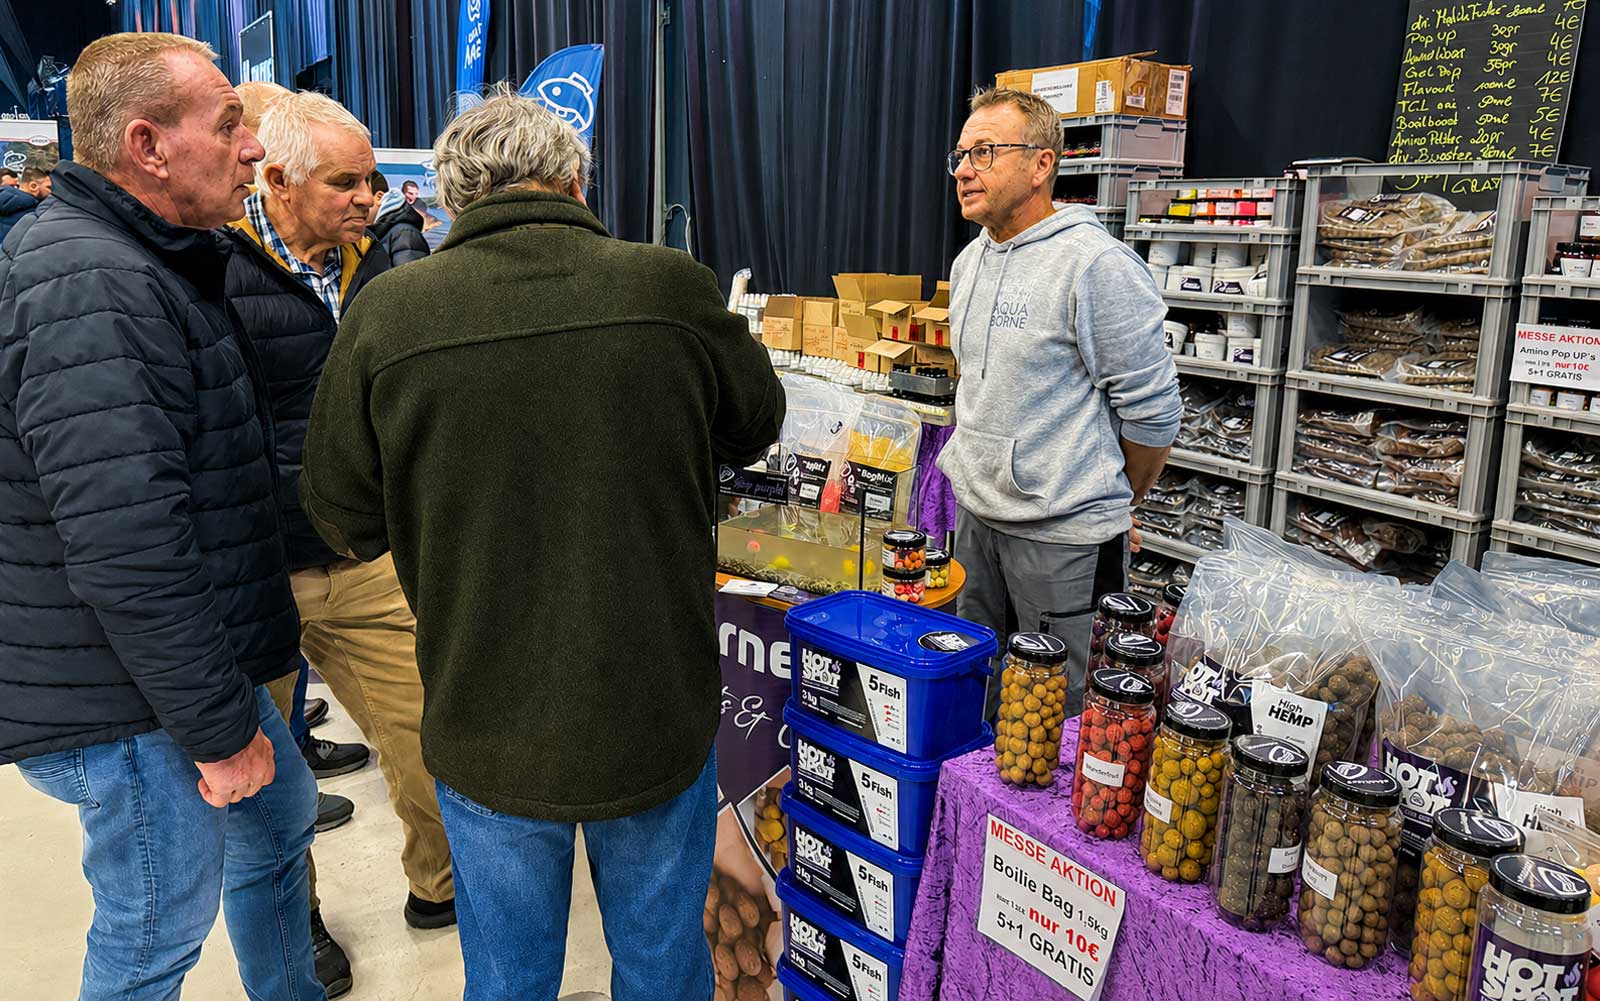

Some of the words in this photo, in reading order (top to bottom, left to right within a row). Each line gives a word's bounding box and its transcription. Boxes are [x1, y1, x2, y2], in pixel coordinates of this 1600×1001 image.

[1406, 32, 1433, 48] Pop
[1491, 24, 1520, 38] 30gr
[1555, 13, 1580, 30] 4€
[1550, 31, 1573, 50] 4€
[1547, 50, 1571, 66] 4€
[1534, 70, 1570, 86] 12€
[1538, 87, 1563, 102] 7€
[1530, 106, 1560, 123] 5€
[1529, 125, 1555, 140] 4€
[1529, 143, 1556, 158] 7€
[992, 301, 1028, 317] AQUA
[990, 315, 1027, 330] BORNE
[1517, 330, 1556, 342] MESSE
[1558, 334, 1600, 345] AKTION
[1520, 347, 1549, 356] Amino
[1551, 348, 1571, 360] Pop
[1573, 351, 1596, 361] UP's
[1528, 368, 1544, 376] 5+1
[1546, 370, 1583, 381] GRATIS
[719, 622, 792, 679] rne
[802, 648, 832, 672] HOT
[802, 665, 841, 688] SPOT
[1268, 705, 1314, 728] HEMP
[1278, 699, 1303, 714] High
[797, 739, 827, 765] HOT
[797, 759, 835, 782] SPOT
[1385, 751, 1440, 791] HOT
[795, 826, 824, 853] HOT
[795, 847, 832, 872] SPOT
[990, 819, 1047, 865] MESSE
[1050, 856, 1117, 908] AKTION
[993, 854, 1037, 893] Boilie
[1041, 883, 1074, 919] Bag
[1077, 909, 1109, 940] 1,5kg
[789, 913, 818, 938] HOT
[1029, 907, 1061, 935] nur
[1065, 928, 1101, 963] 10€
[790, 930, 826, 958] SPOT
[996, 911, 1024, 940] 5+1
[1029, 932, 1095, 987] GRATIS
[1481, 940, 1566, 991] HOT
